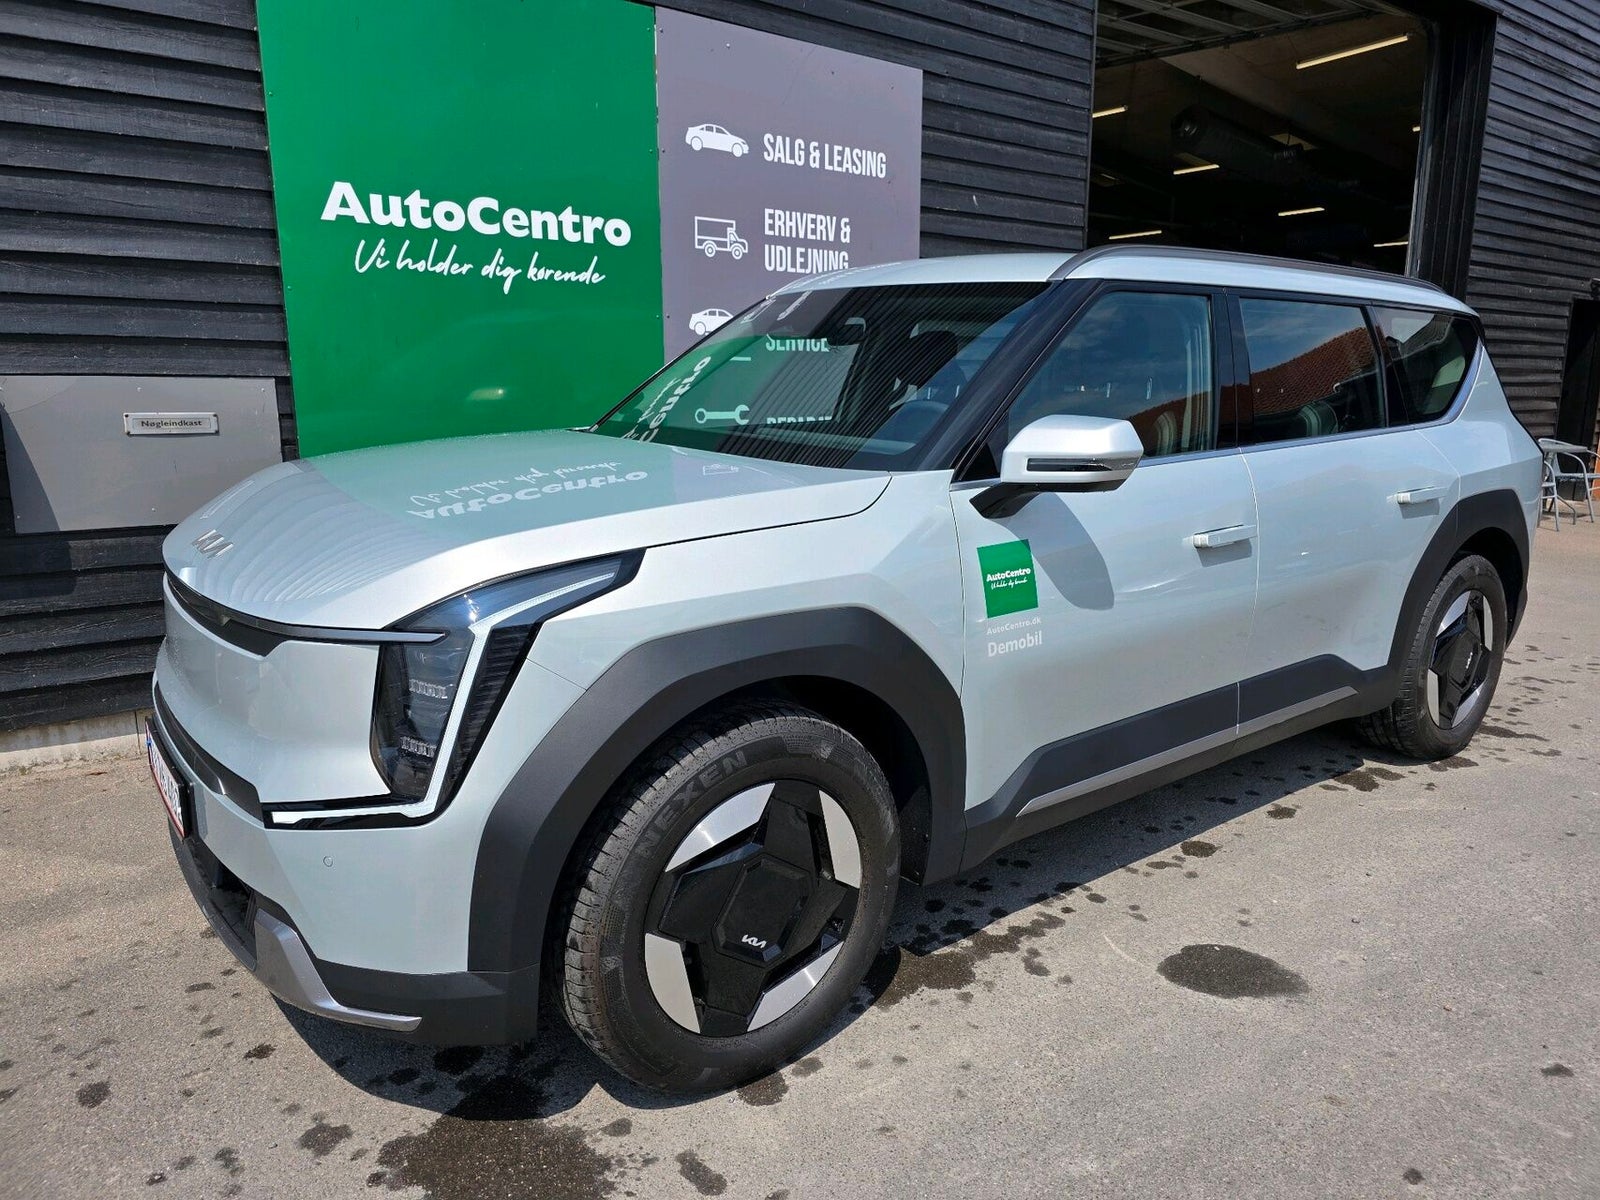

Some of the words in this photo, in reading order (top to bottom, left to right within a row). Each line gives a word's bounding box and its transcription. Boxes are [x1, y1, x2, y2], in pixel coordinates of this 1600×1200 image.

[763, 133, 805, 166] SALG
[809, 141, 820, 168] &
[824, 143, 887, 178] LEASING
[321, 180, 632, 247] AutoCentro
[764, 207, 836, 242] ERHVERV
[840, 217, 851, 243] &
[354, 238, 390, 273] Vi
[396, 238, 473, 275] holder
[481, 248, 522, 294] dig
[527, 251, 606, 284] kørende
[764, 244, 849, 274] UDLEJNING
[141, 420, 202, 428] Nøgleindkast
[986, 568, 1031, 582] AutoCentro
[986, 617, 1042, 636] AutoCentro.dk
[987, 630, 1043, 657] Demobil
